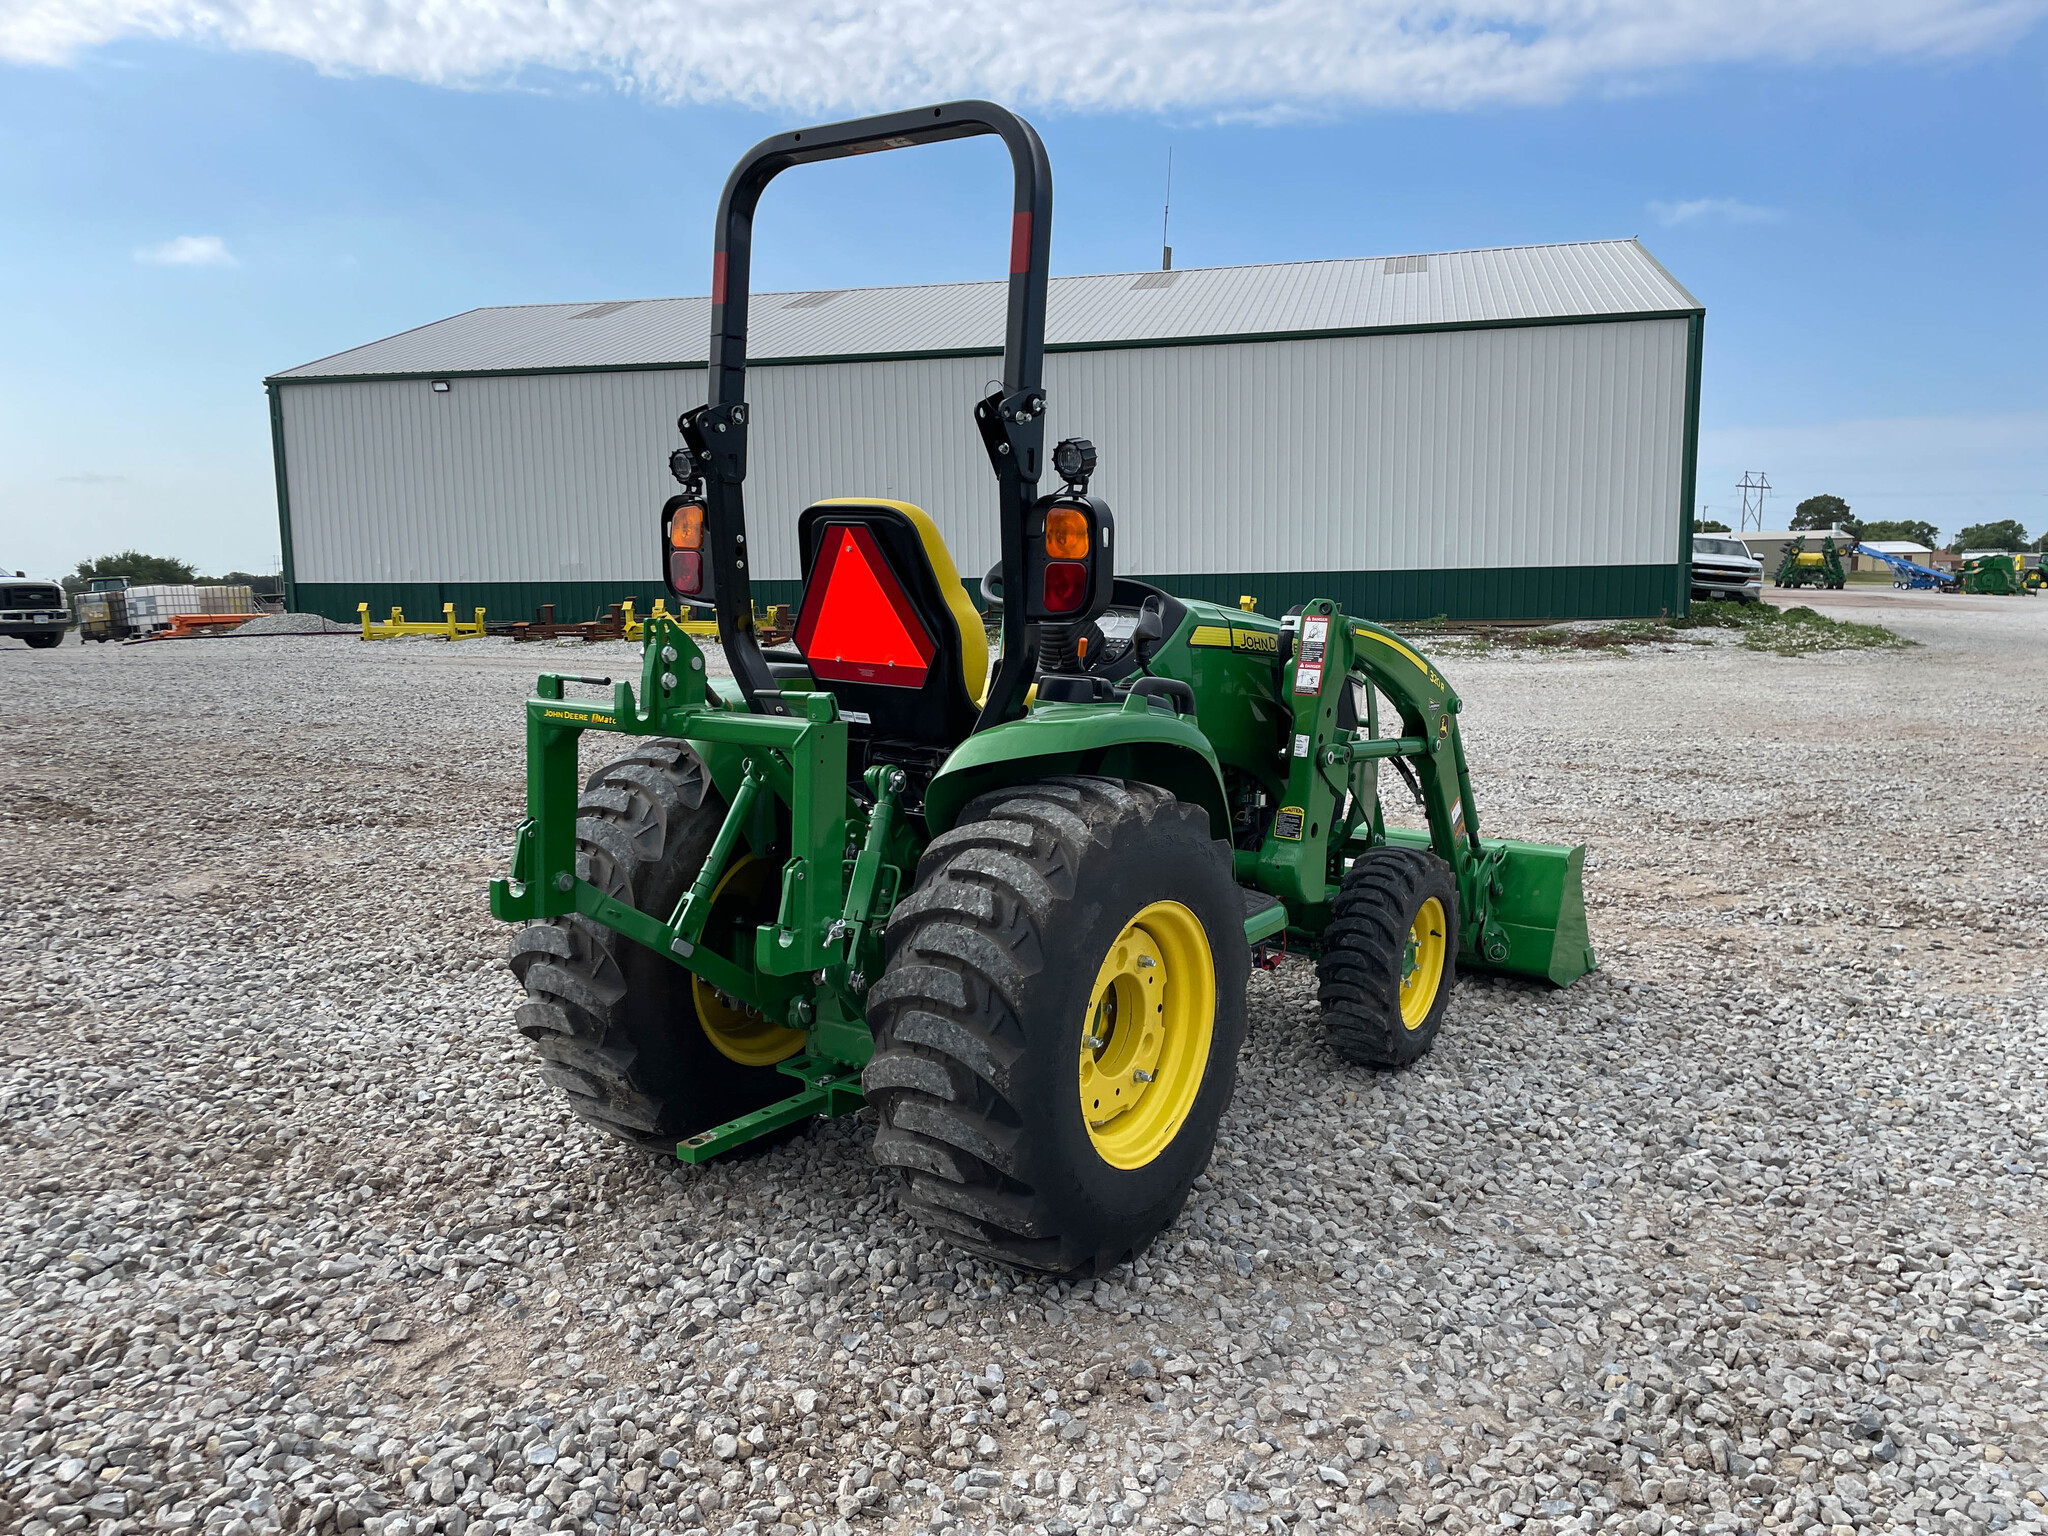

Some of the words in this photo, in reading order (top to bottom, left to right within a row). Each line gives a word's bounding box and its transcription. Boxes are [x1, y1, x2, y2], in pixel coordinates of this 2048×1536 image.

[1240, 633, 1268, 650] JOHN
[544, 709, 563, 718] JOHN
[564, 711, 588, 721] DEERE
